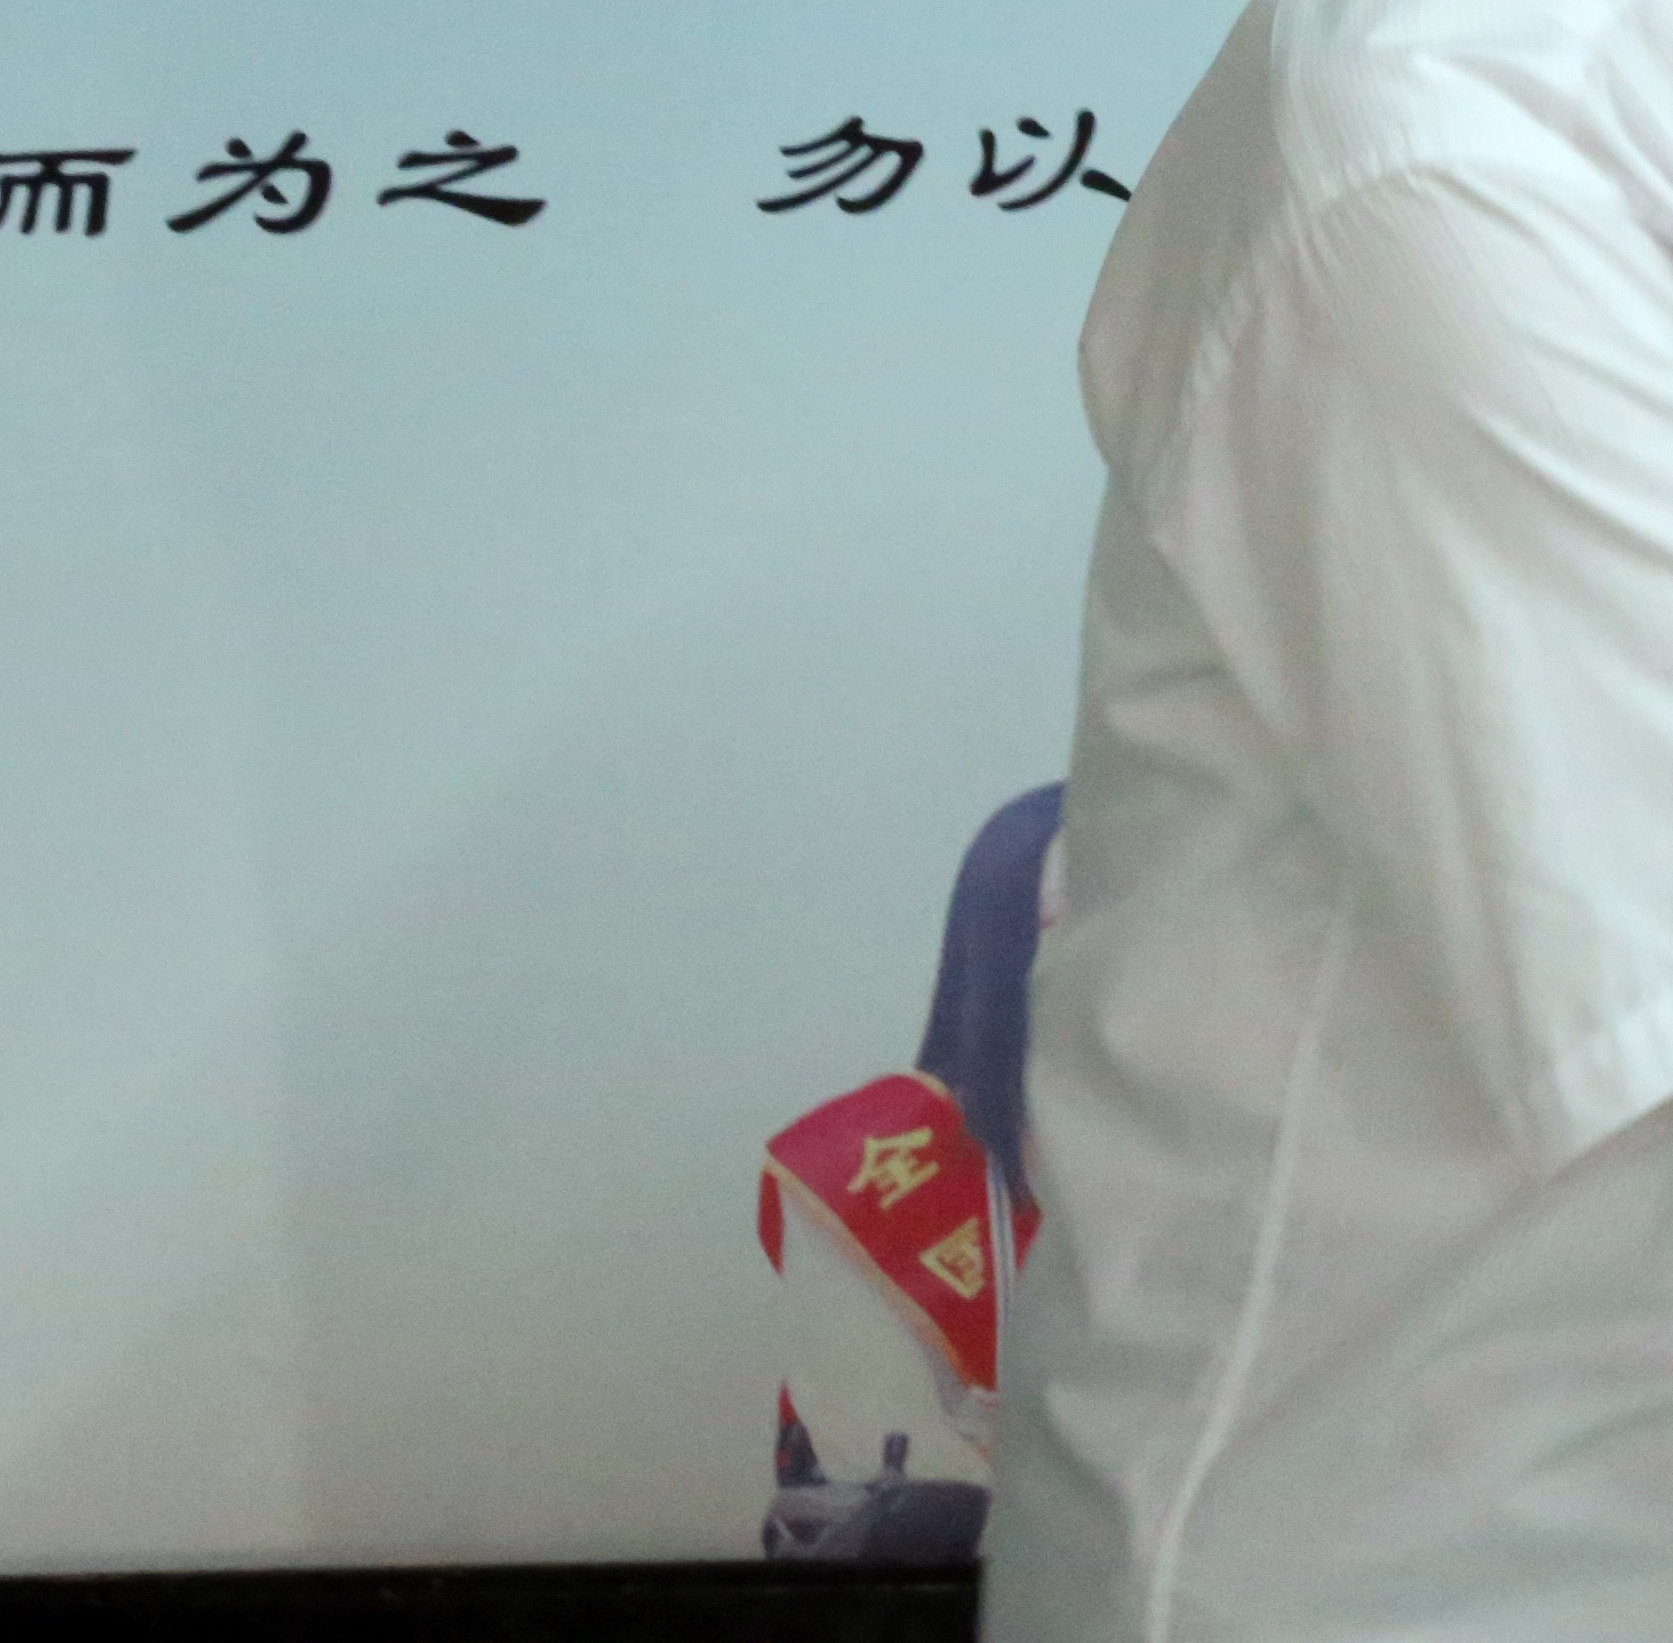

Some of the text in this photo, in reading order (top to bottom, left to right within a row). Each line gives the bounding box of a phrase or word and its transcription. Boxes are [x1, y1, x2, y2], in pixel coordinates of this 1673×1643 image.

[0, 108, 1132, 237] 而为之 勿以
